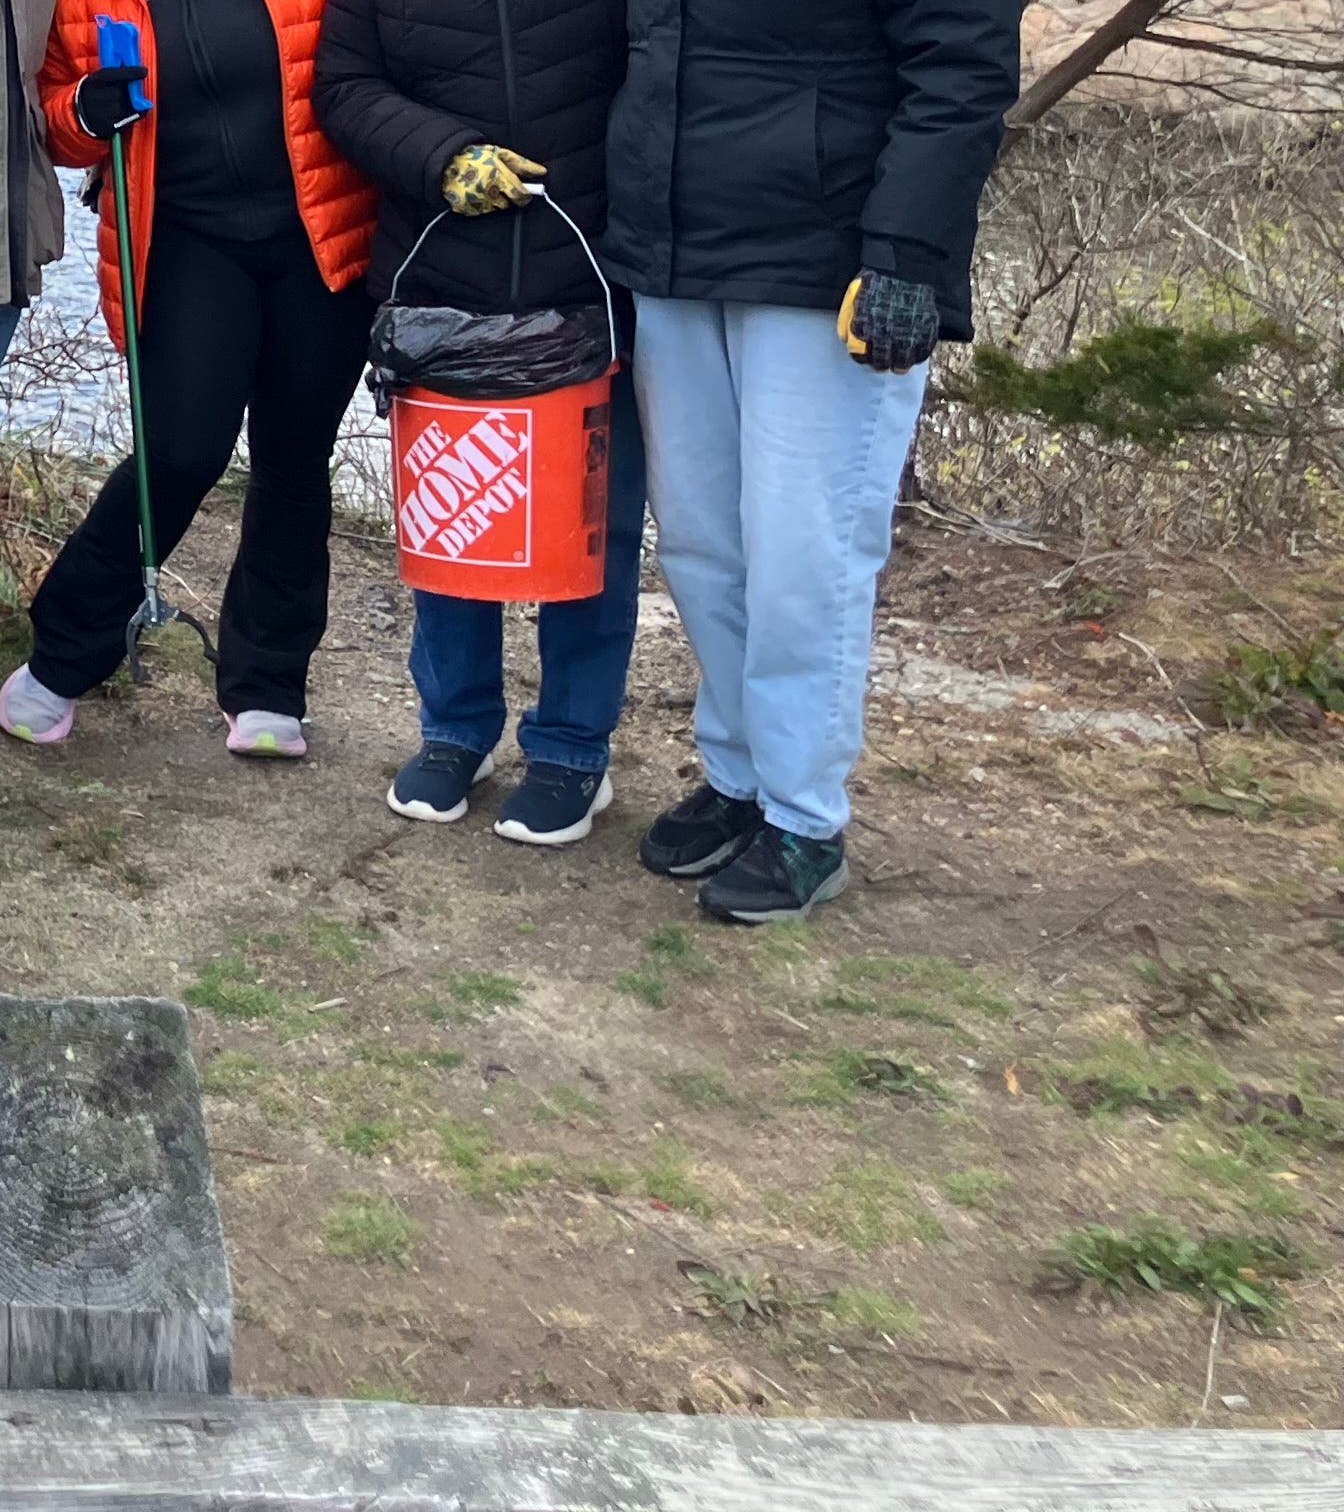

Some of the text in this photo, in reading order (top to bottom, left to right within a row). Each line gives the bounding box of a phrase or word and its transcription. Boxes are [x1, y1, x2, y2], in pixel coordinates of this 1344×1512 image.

[400, 409, 528, 552] HOME
[403, 419, 452, 479] THE
[436, 467, 528, 559] DEPOT
